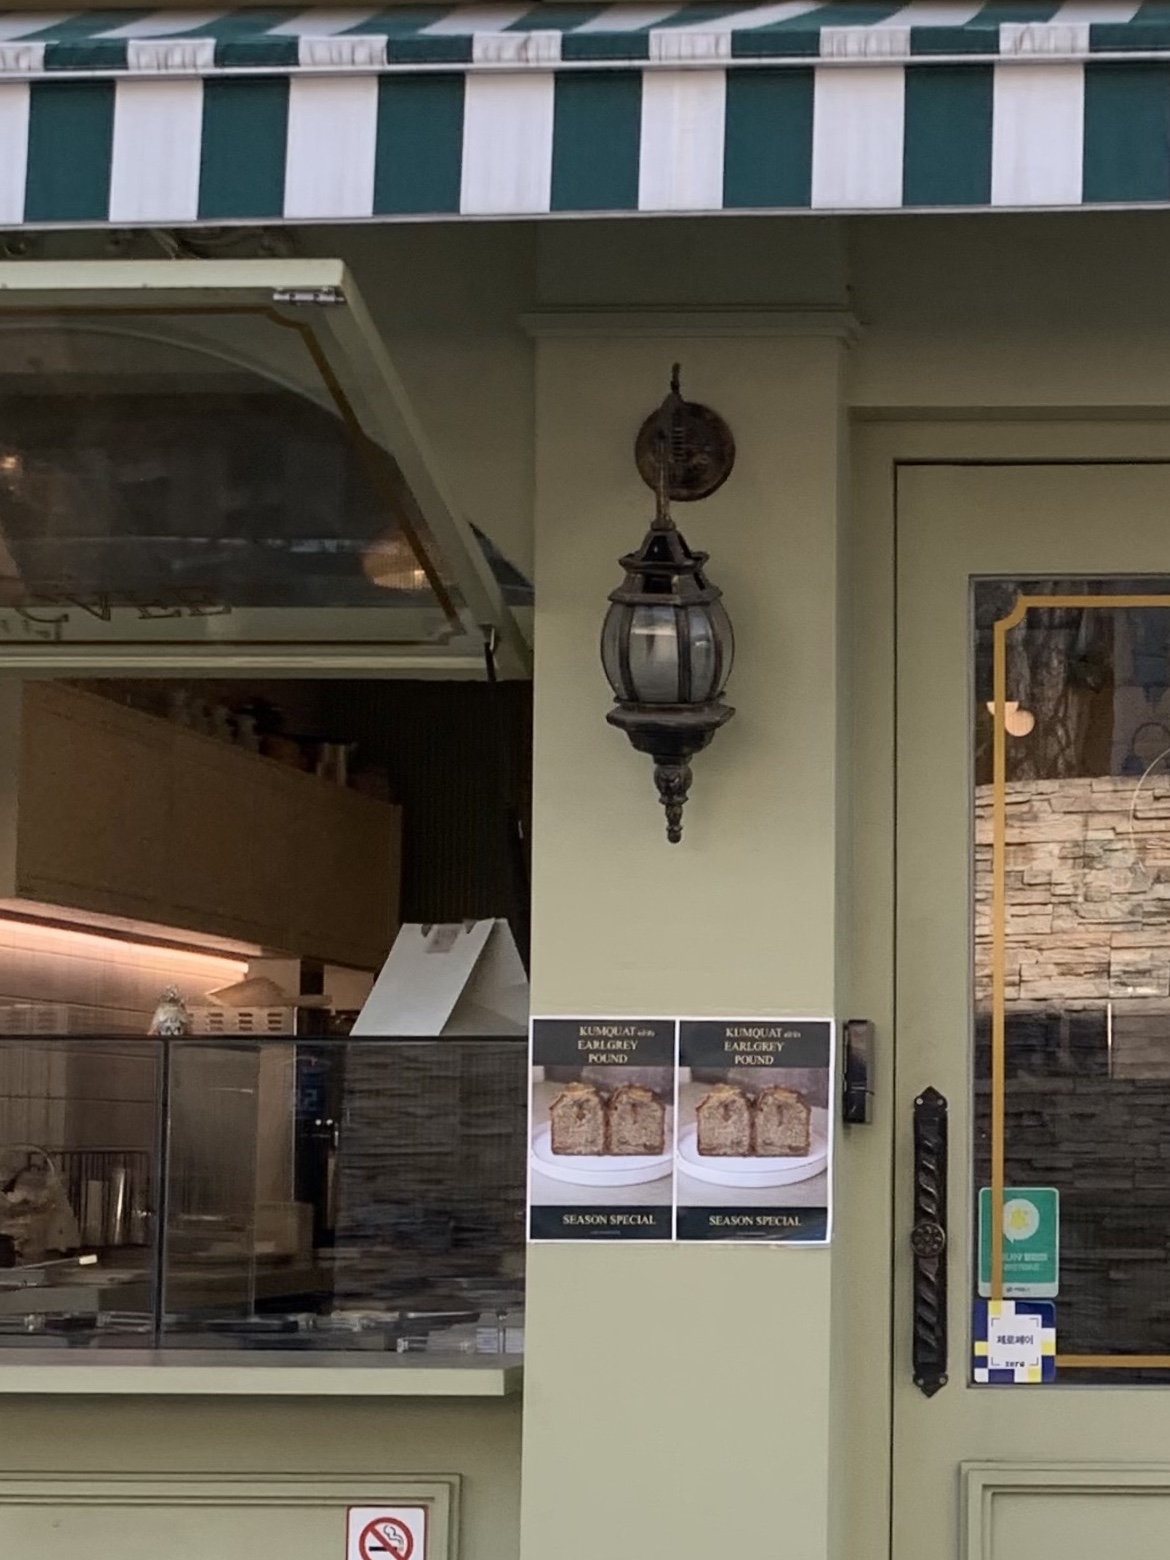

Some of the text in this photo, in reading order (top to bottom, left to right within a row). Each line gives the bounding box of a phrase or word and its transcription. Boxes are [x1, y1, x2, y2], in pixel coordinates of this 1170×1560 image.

[578, 1026, 637, 1038] KUMQUAT
[725, 1027, 783, 1039] KUMQUAT
[577, 1040, 639, 1050] EARLGREY
[723, 1041, 785, 1051] EARLGREY
[588, 1053, 628, 1063] POUND
[734, 1054, 775, 1065] POUND
[562, 1214, 657, 1226] SEASON SPECIAL
[708, 1215, 802, 1227] SEASON SPECIAL
